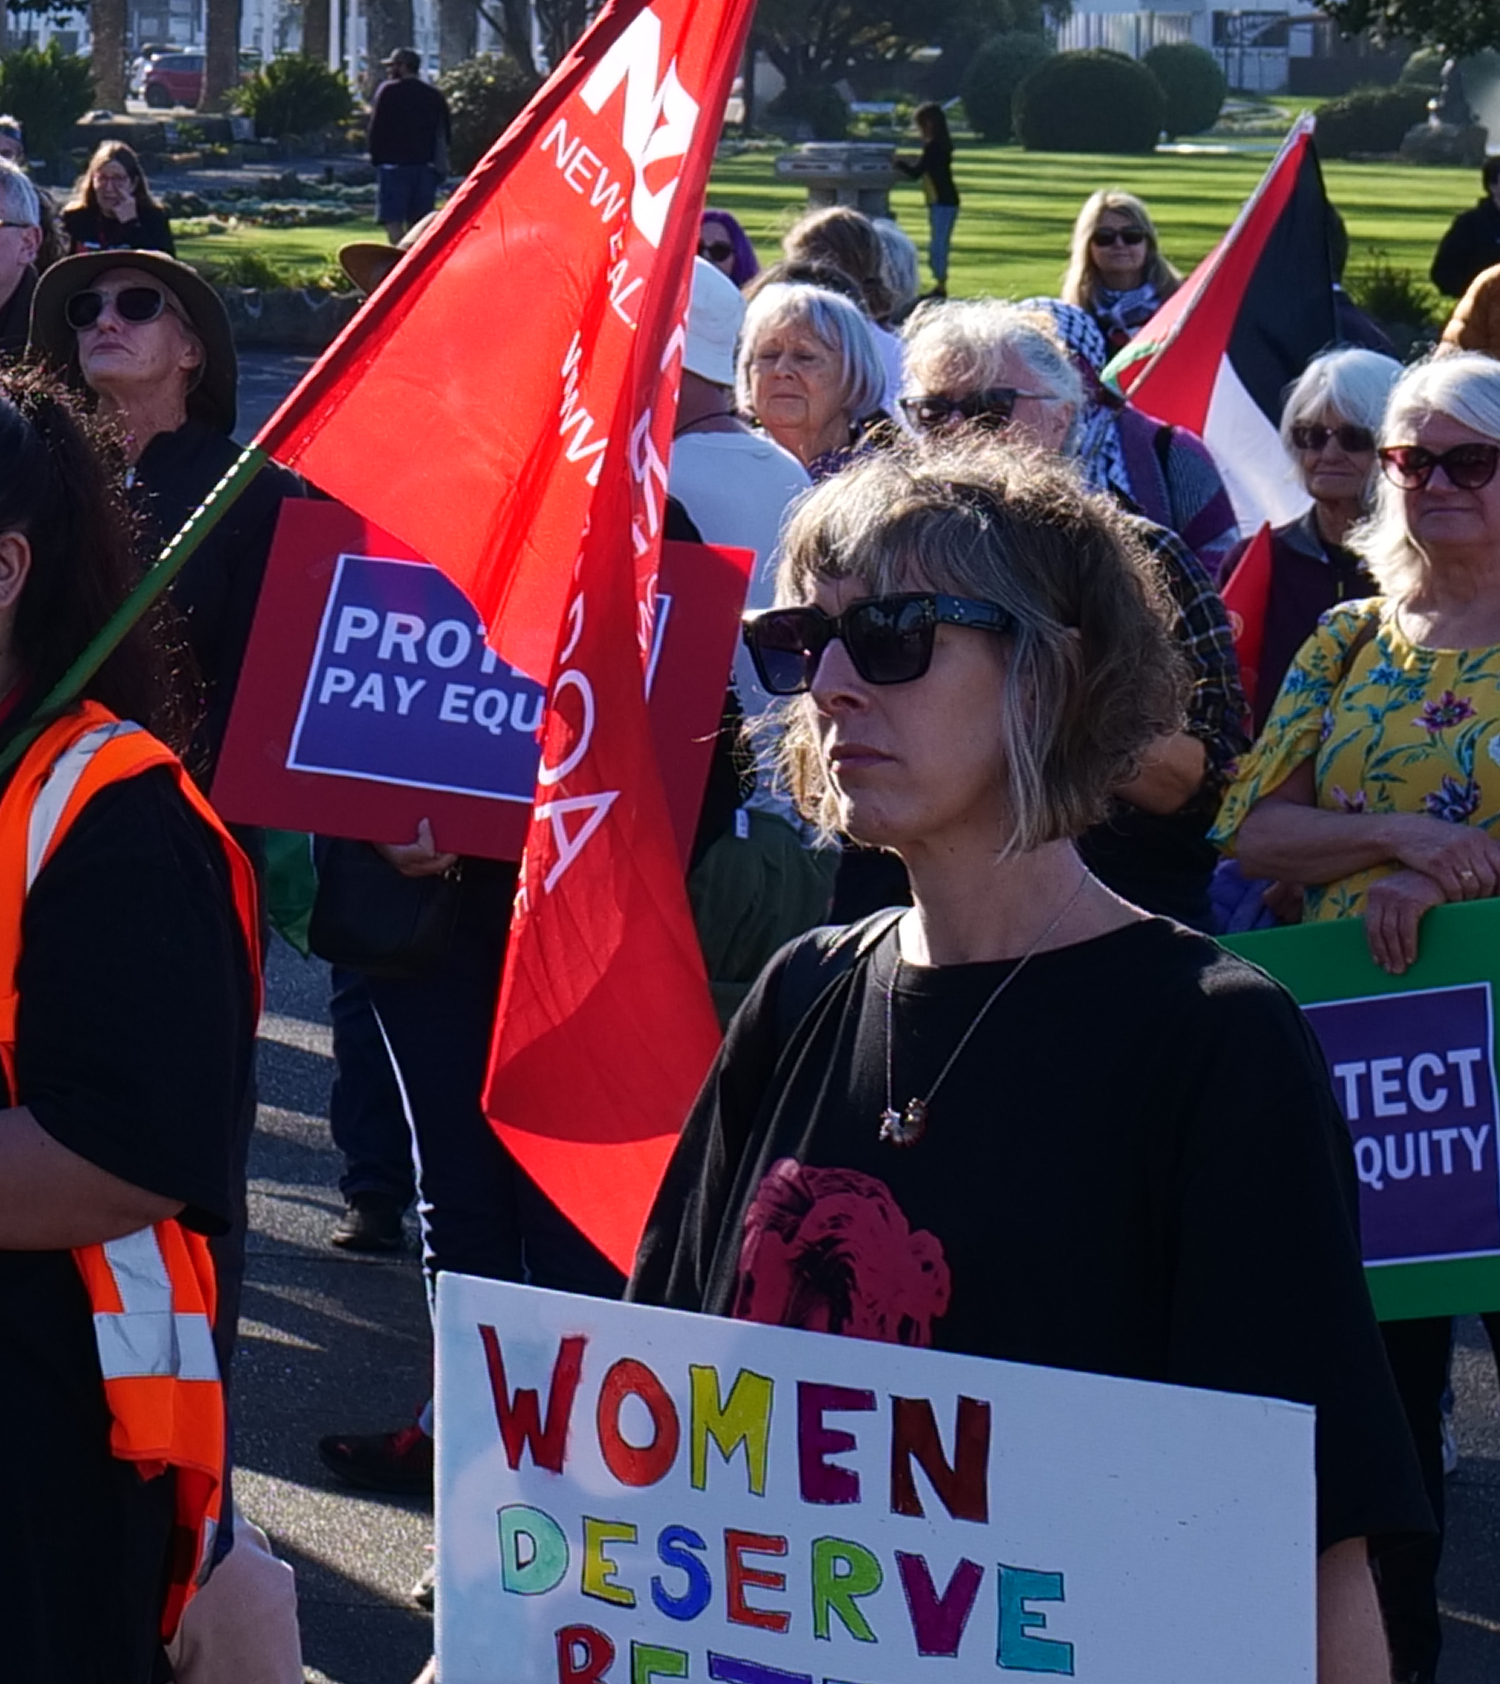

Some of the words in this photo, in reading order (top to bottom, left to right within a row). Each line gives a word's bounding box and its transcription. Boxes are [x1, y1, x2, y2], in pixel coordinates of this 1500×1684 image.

[540, 117, 626, 226] NEW
[319, 666, 427, 716] PAY
[438, 682, 546, 736] EQU
[1333, 1047, 1483, 1120] TECT
[1353, 1123, 1491, 1191] QUITY
[478, 1323, 992, 1524] WOMEN
[497, 1502, 1074, 1676] DESERVE
